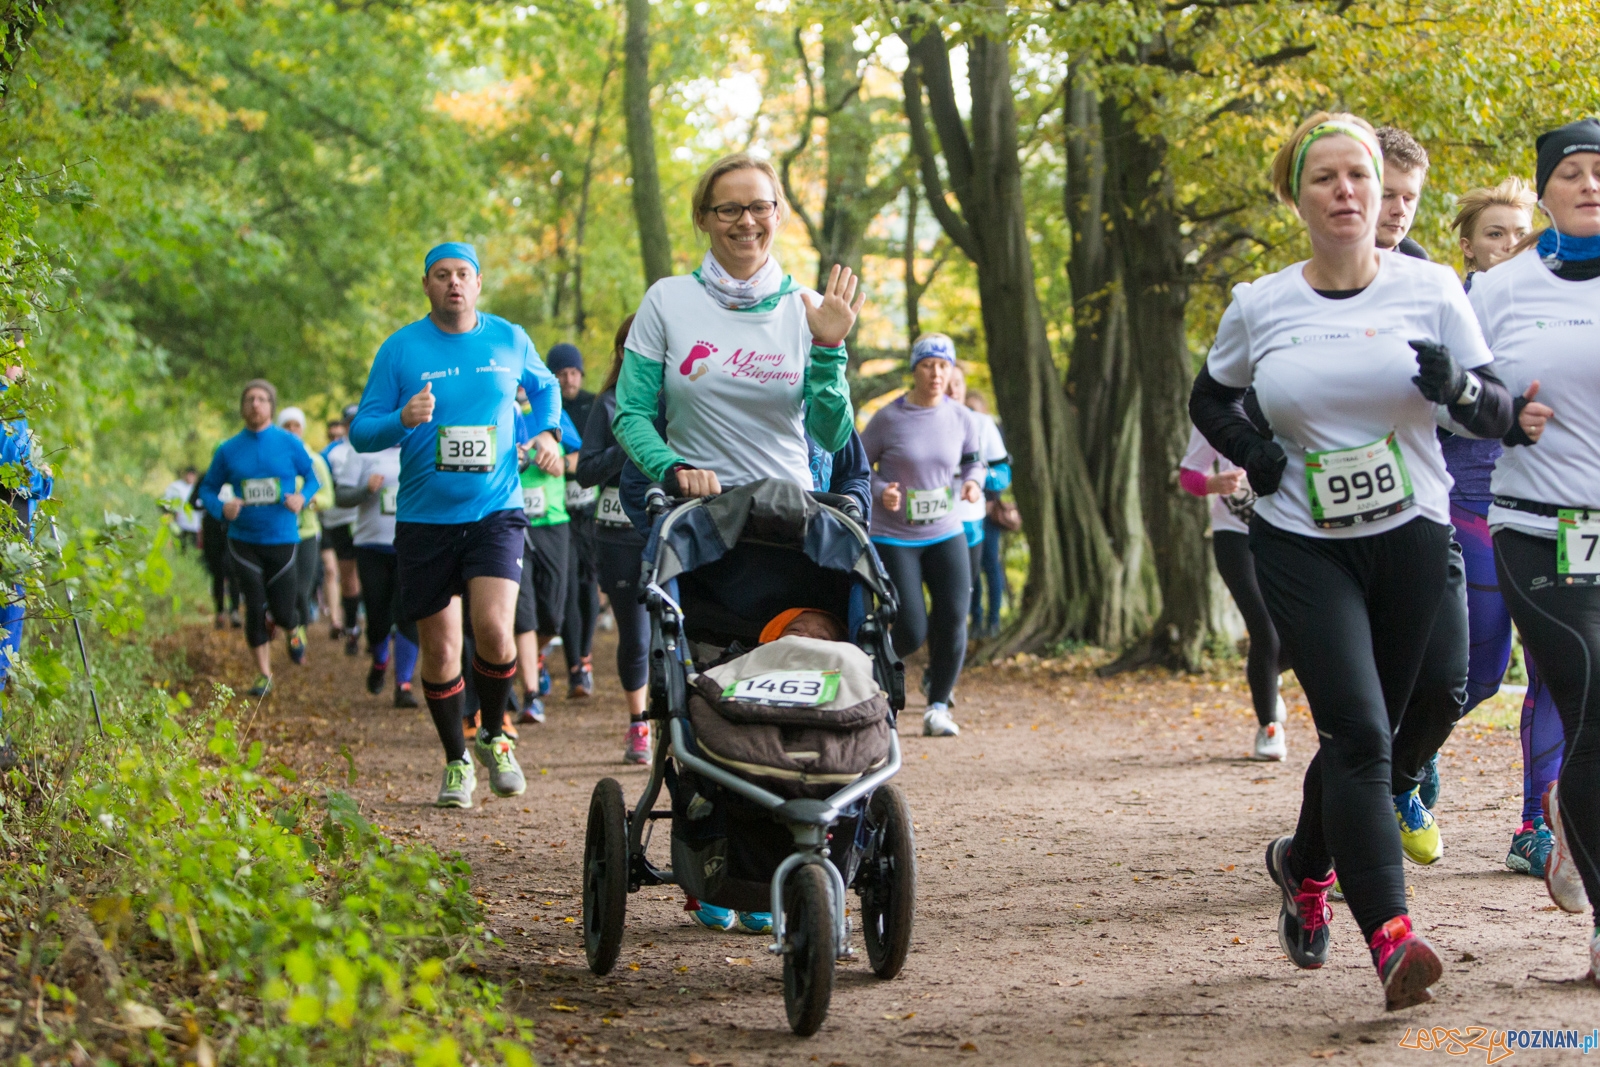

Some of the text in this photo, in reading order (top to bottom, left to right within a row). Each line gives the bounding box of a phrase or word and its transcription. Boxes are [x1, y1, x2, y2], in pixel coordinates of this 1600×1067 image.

[722, 347, 786, 367] Mamy
[448, 441, 487, 458] 382
[1328, 463, 1395, 504] 998
[915, 500, 948, 514] 1374
[746, 679, 821, 695] 1463
